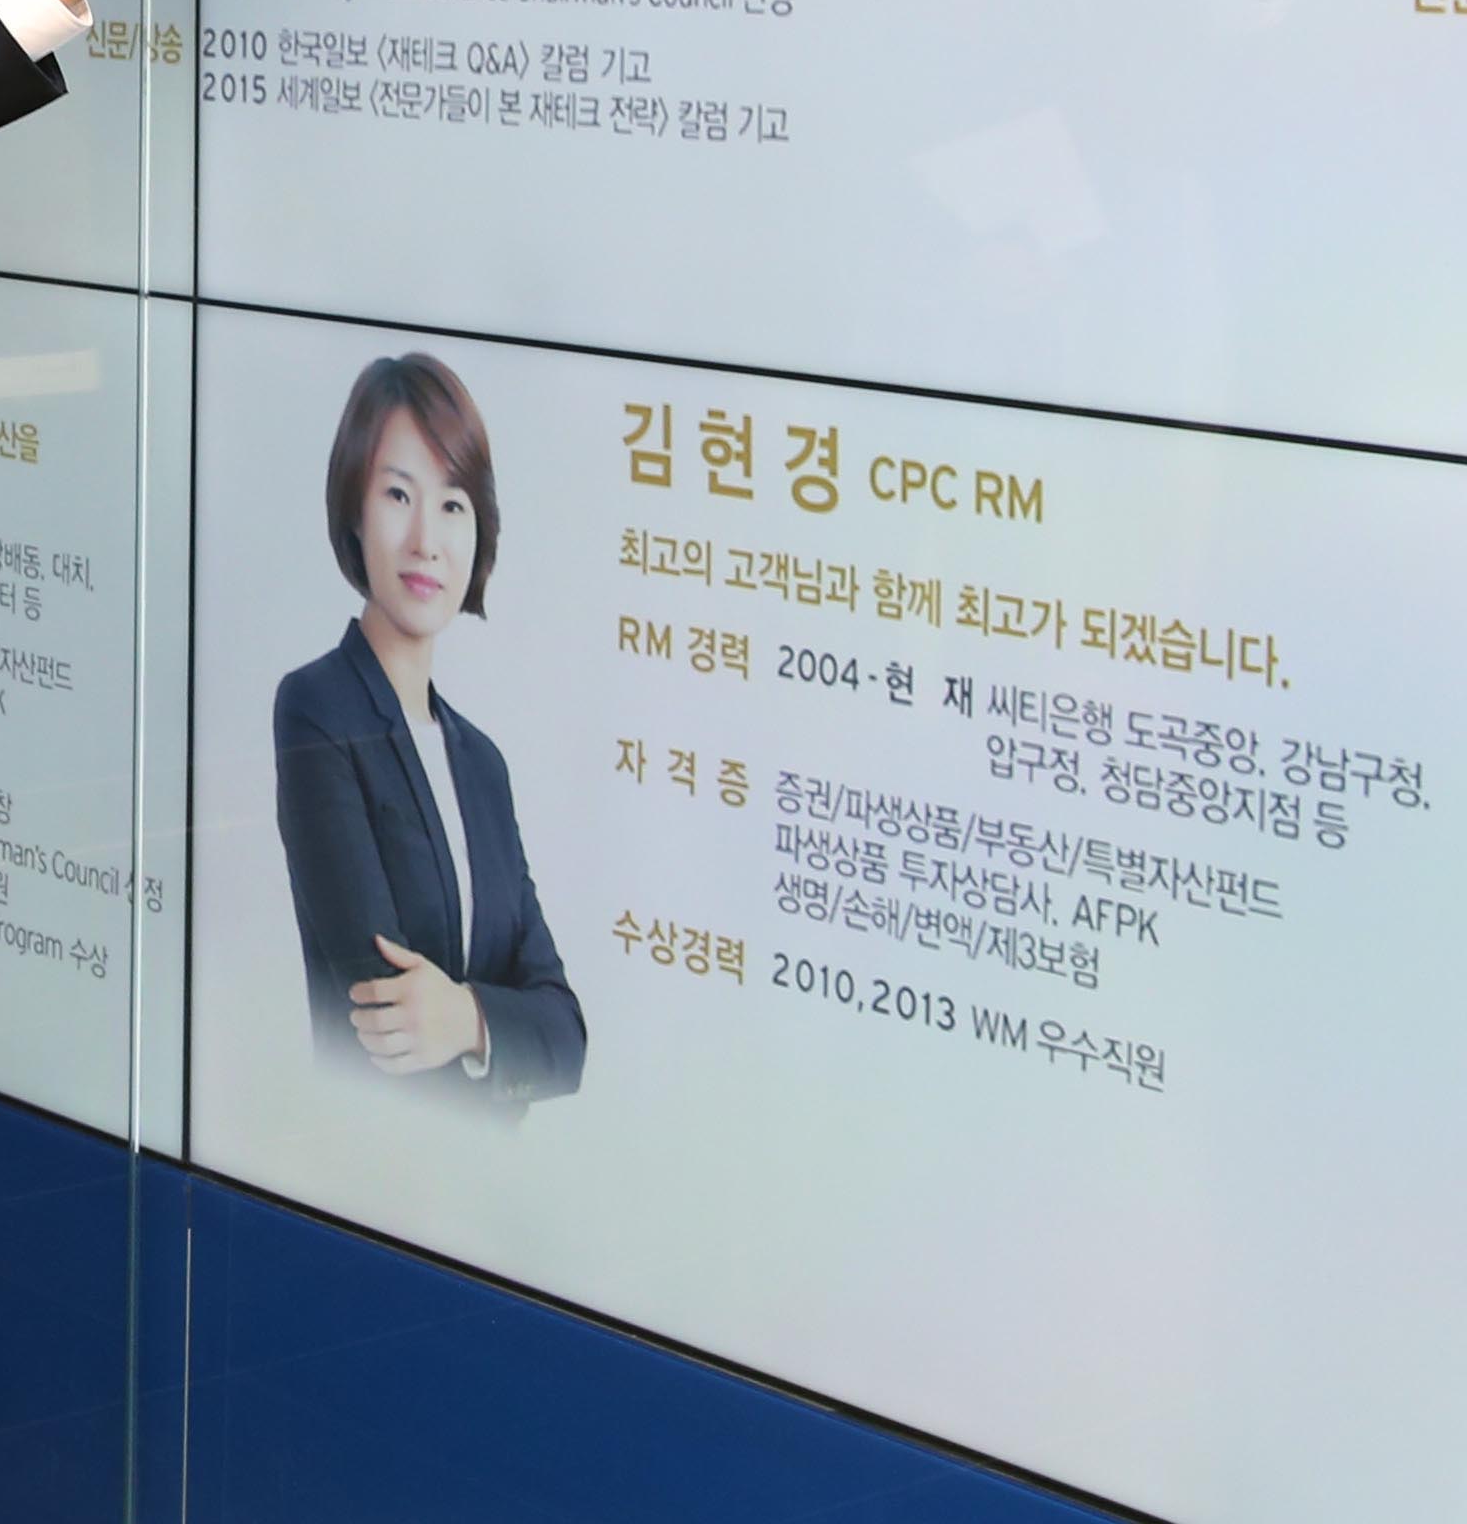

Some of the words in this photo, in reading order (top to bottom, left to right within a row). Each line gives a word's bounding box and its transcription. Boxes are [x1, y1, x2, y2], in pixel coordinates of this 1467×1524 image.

[203, 29, 268, 61] 2010
[278, 29, 370, 69] 한국일보
[540, 43, 589, 84] 칼럼
[601, 45, 652, 85] 기고
[203, 74, 268, 106] 2015
[277, 76, 363, 115] 세계일보
[498, 87, 522, 127] 본
[529, 90, 602, 131] 재테크
[678, 99, 728, 142] 칼럼
[739, 102, 791, 145] 기고
[869, 454, 958, 511] CPC
[974, 469, 1044, 524] RM
[22, 586, 43, 622] 등
[619, 526, 713, 589] 최고의
[724, 546, 860, 614] 고객님과
[872, 566, 942, 629] 함께
[955, 583, 1067, 651] 최고가
[1079, 606, 1290, 691] 되겠습니다.
[618, 614, 673, 660] RM
[687, 625, 751, 682] 경력
[986, 684, 1114, 748] 씨티은행
[1099, 755, 1302, 842] 청담중앙지점
[1313, 800, 1350, 851] 등
[51, 852, 121, 898] Council
[774, 823, 890, 887] 파생상품
[1071, 893, 1161, 947] AFPK
[68, 935, 109, 981] 수상
[773, 869, 1101, 991] 생명/손해/변액/제3보험
[610, 908, 746, 986] 수상경력
[771, 951, 957, 1033] 2010,2013
[971, 1004, 1029, 1054] WM
[1035, 1018, 1166, 1094] 우수직원
